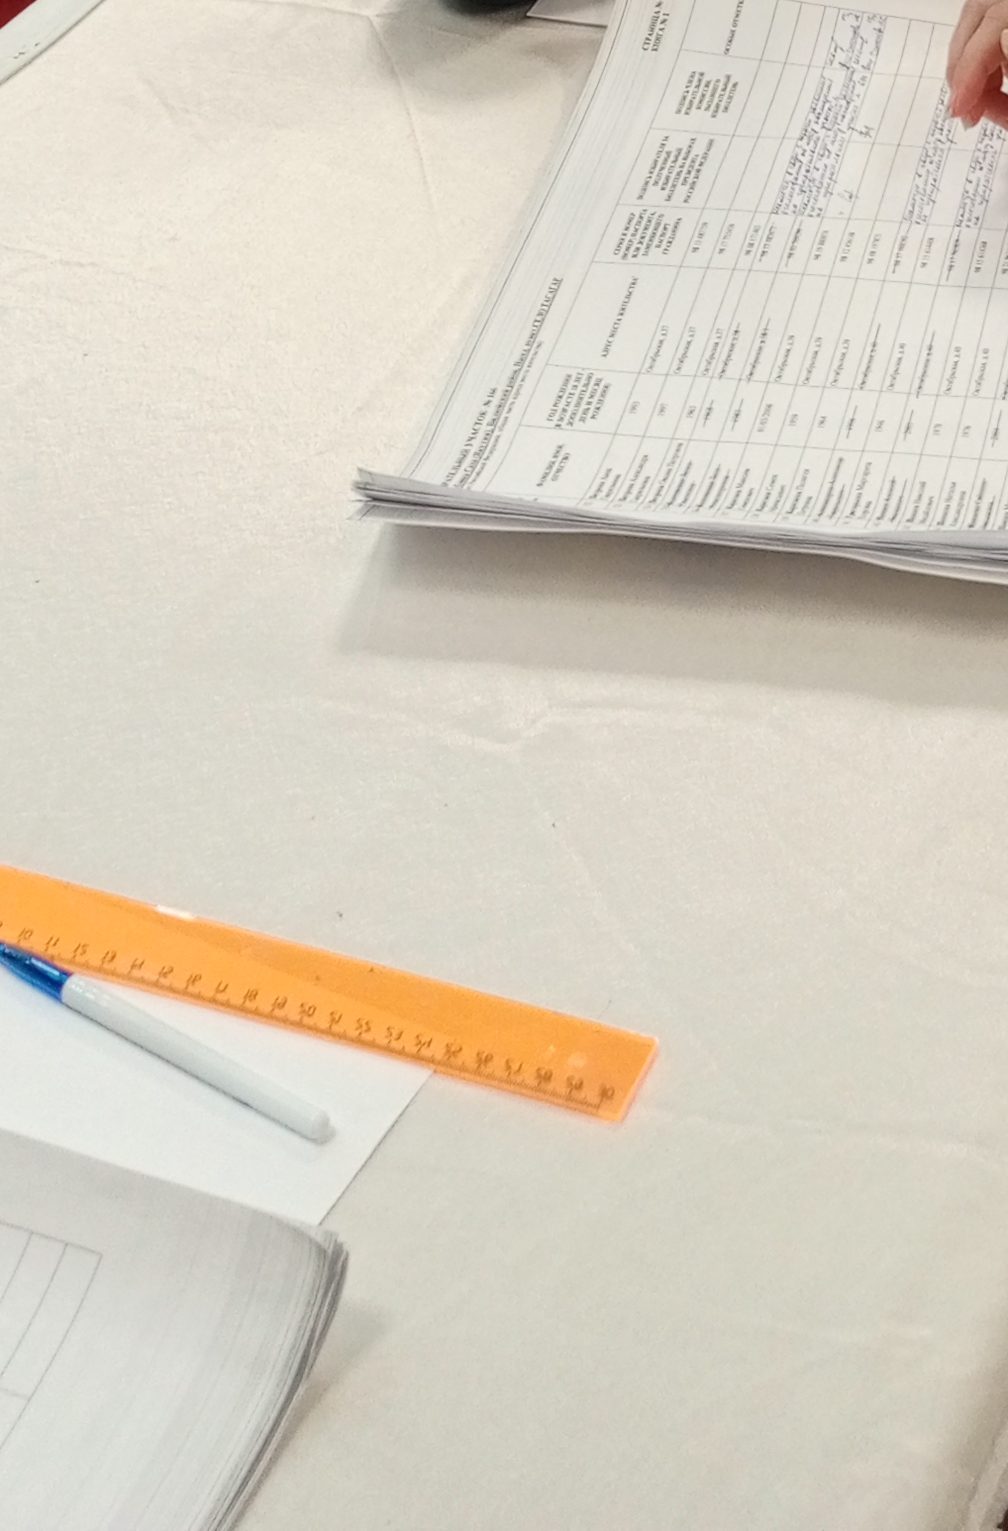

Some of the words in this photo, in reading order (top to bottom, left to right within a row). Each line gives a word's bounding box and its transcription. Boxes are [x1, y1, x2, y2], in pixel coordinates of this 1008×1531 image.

[640, 9, 661, 51] СТРАНИЦА
[650, 26, 666, 52] КНИГА
[539, 276, 561, 307] ТАСАГАР
